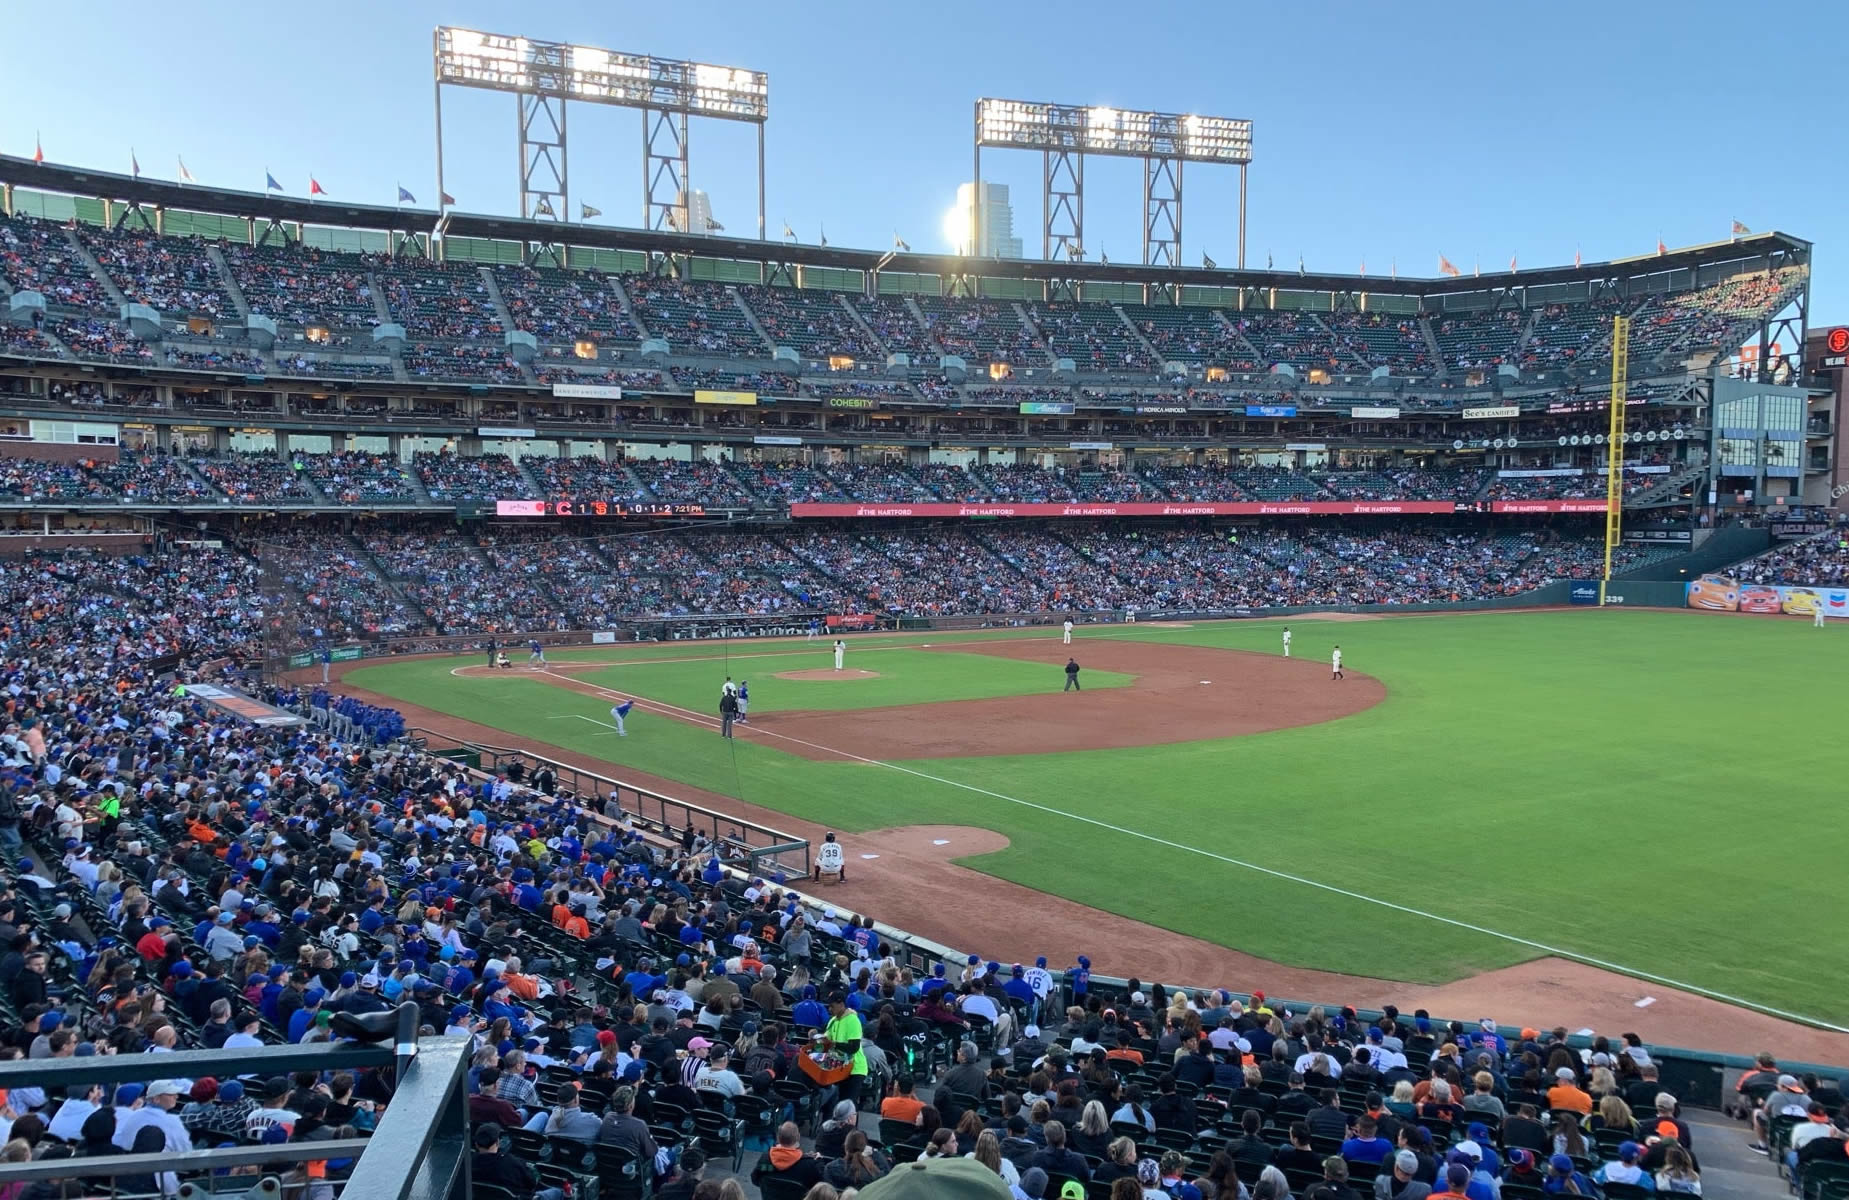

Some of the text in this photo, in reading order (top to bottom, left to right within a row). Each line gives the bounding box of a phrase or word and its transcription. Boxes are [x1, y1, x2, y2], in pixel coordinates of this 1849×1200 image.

[830, 398, 873, 408] COHESITY
[1487, 409, 1516, 417] CANDIES
[579, 504, 586, 514] 1
[615, 504, 622, 514] 1
[635, 504, 642, 513] 0
[650, 504, 656, 513] 1
[664, 504, 671, 513] 2
[691, 505, 702, 513] PM
[1605, 595, 1625, 603] 339
[825, 848, 839, 858] 39
[1028, 976, 1042, 990] 16
[700, 1078, 720, 1089] PENCE
